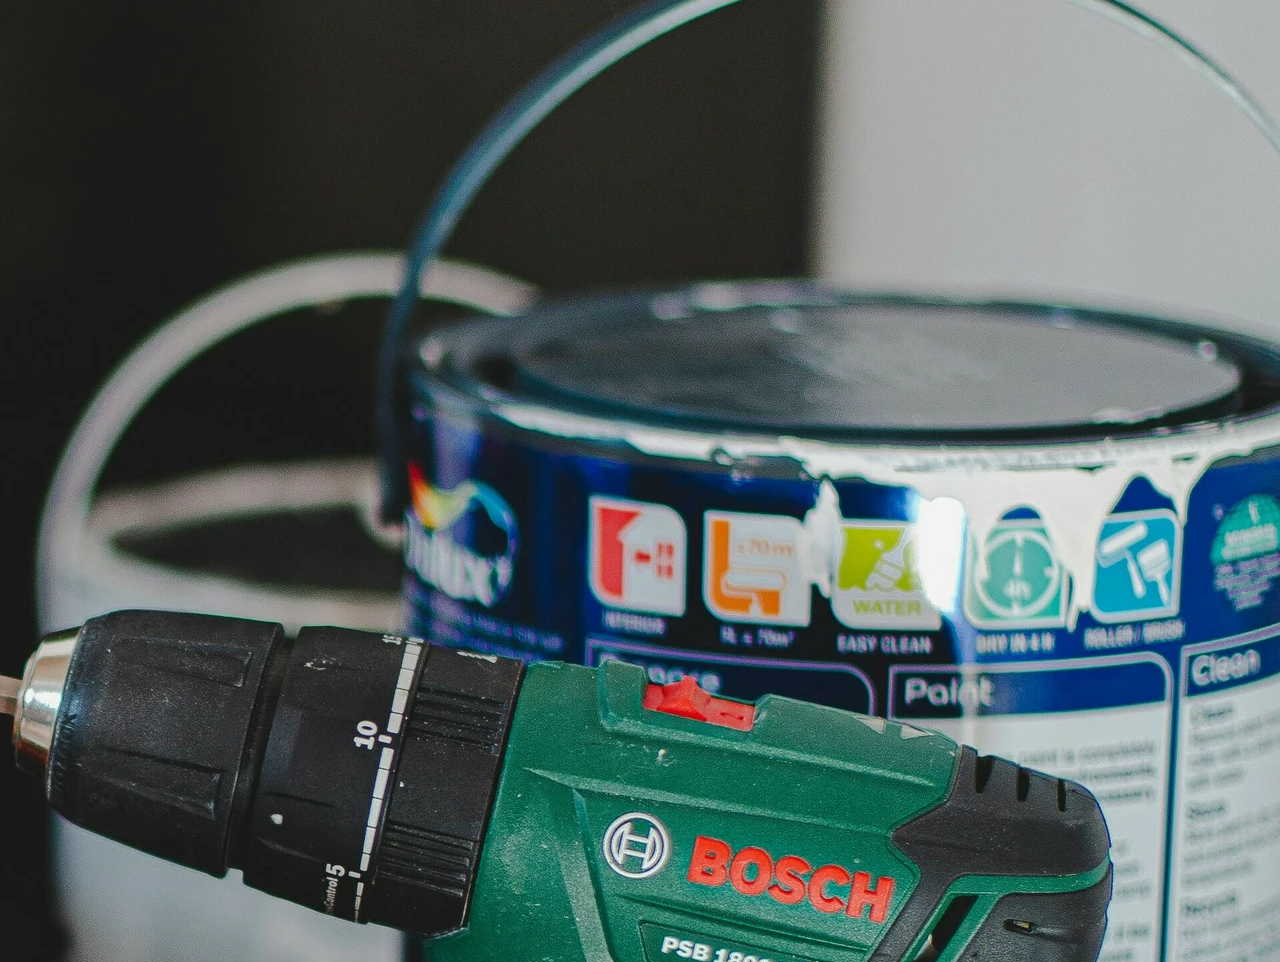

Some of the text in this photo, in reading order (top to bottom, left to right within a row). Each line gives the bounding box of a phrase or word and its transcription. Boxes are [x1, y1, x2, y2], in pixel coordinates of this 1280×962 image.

[852, 599, 922, 617] WATER
[837, 633, 933, 654] EASY CLEAN
[975, 633, 1008, 655] DRY
[1191, 648, 1261, 687] Clean
[905, 676, 994, 707] Paint
[353, 720, 378, 750] 10
[325, 863, 345, 877] 5
[687, 835, 896, 924] BOSCH
[660, 936, 710, 962] PSB
